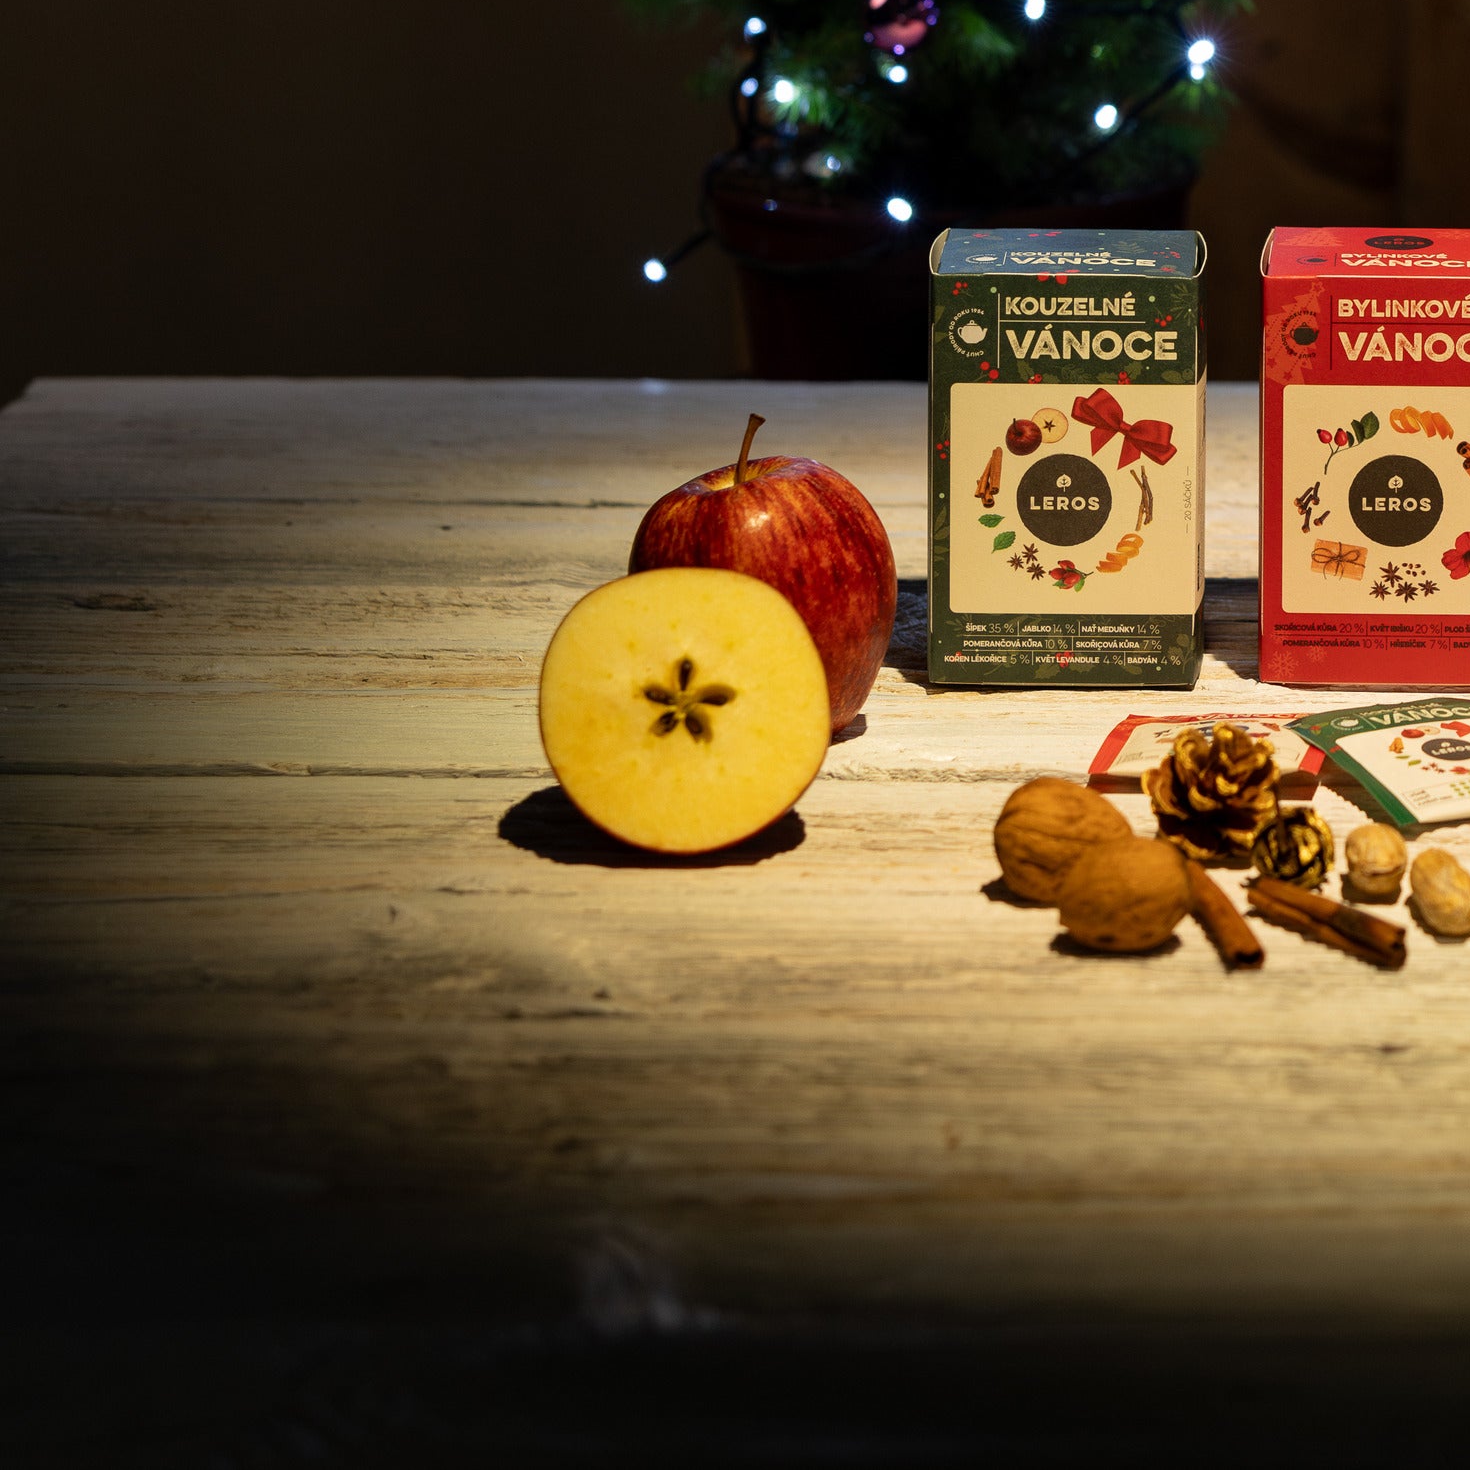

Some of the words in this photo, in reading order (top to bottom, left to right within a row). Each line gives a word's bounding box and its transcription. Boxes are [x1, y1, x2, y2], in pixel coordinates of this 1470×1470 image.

[1010, 257, 1156, 267] VÁNOCE
[1005, 291, 1136, 316] KOUZELNÉ
[949, 321, 956, 330] OD
[954, 309, 970, 320] ROKU
[1005, 324, 1178, 361] VÁNOCE
[1183, 480, 1192, 508] SÁČKŮ
[1030, 496, 1100, 511] LEROS
[1361, 497, 1432, 512] LEROS
[1184, 511, 1192, 520] 20
[966, 623, 987, 632] ŠÍPEK
[988, 623, 1002, 634] 35
[1004, 624, 1014, 634] %
[1052, 624, 1062, 634] 14
[1065, 624, 1076, 634] %
[1082, 624, 1096, 632] NAŤ
[1098, 624, 1135, 633] MEDUŇKY
[1137, 625, 1146, 634] 14
[1150, 625, 1160, 634] %
[1340, 623, 1352, 634] 20
[1354, 623, 1364, 634] %
[1415, 624, 1428, 634] 20
[1430, 624, 1440, 634] %
[964, 638, 1021, 648] POMERANČOVÁ
[1022, 638, 1042, 648] KŮRA
[1044, 639, 1055, 650] 10
[1058, 639, 1068, 650] %
[1076, 640, 1118, 648] SKOŘICOVÁ
[1119, 640, 1140, 648] KŮRA
[1142, 640, 1150, 650] 7
[1151, 640, 1162, 650] %
[1362, 638, 1372, 648] 10
[1374, 639, 1384, 649] %
[1430, 640, 1436, 650] 7
[1438, 640, 1448, 650] %
[944, 654, 970, 662] KOŘEN
[1010, 654, 1017, 664] 5
[1020, 654, 1030, 664] %
[1036, 654, 1055, 663] KVĚT
[1056, 656, 1100, 664] LEVANDULE
[1103, 655, 1110, 664] 4
[1112, 655, 1123, 665] %
[1127, 656, 1158, 664] BADYÁN
[1160, 656, 1168, 665] 4
[1170, 656, 1181, 666] %
